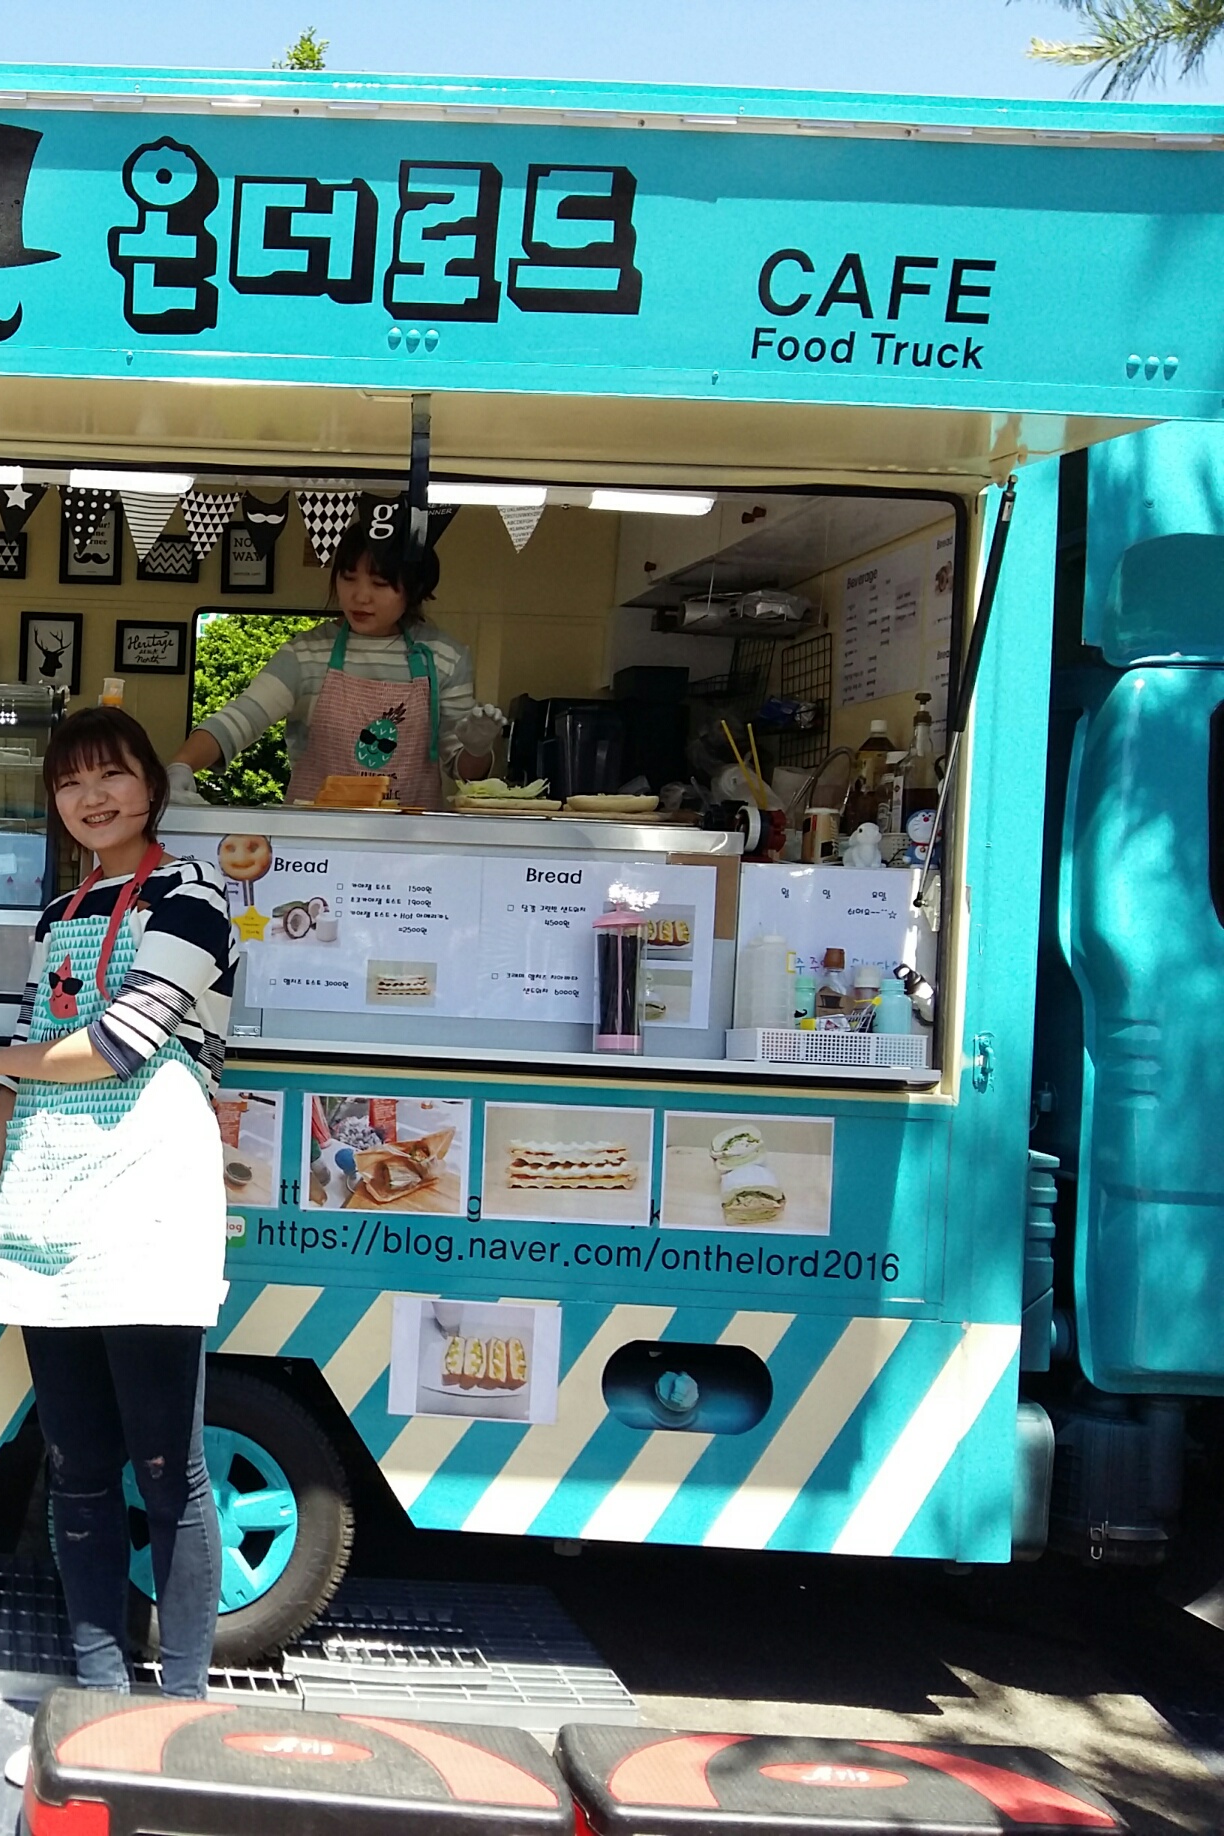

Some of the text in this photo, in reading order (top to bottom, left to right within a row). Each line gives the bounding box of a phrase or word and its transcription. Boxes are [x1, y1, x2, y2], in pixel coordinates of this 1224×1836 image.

[108, 135, 643, 334] 온더로드
[758, 248, 997, 325] CAFE
[751, 327, 984, 370] Food Truck
[369, 503, 399, 540] g
[847, 568, 879, 590] Beverage
[127, 631, 174, 653] Heritage
[274, 856, 330, 874] Bread
[526, 867, 583, 885] Bread
[408, 885, 433, 894] 1500원
[400, 912, 413, 920] Hot
[544, 919, 571, 929] 4500원
[324, 980, 350, 990] 3000원
[554, 988, 580, 998] 6000원
[257, 1217, 902, 1282] https://blog.naver.com/onthelord2016
